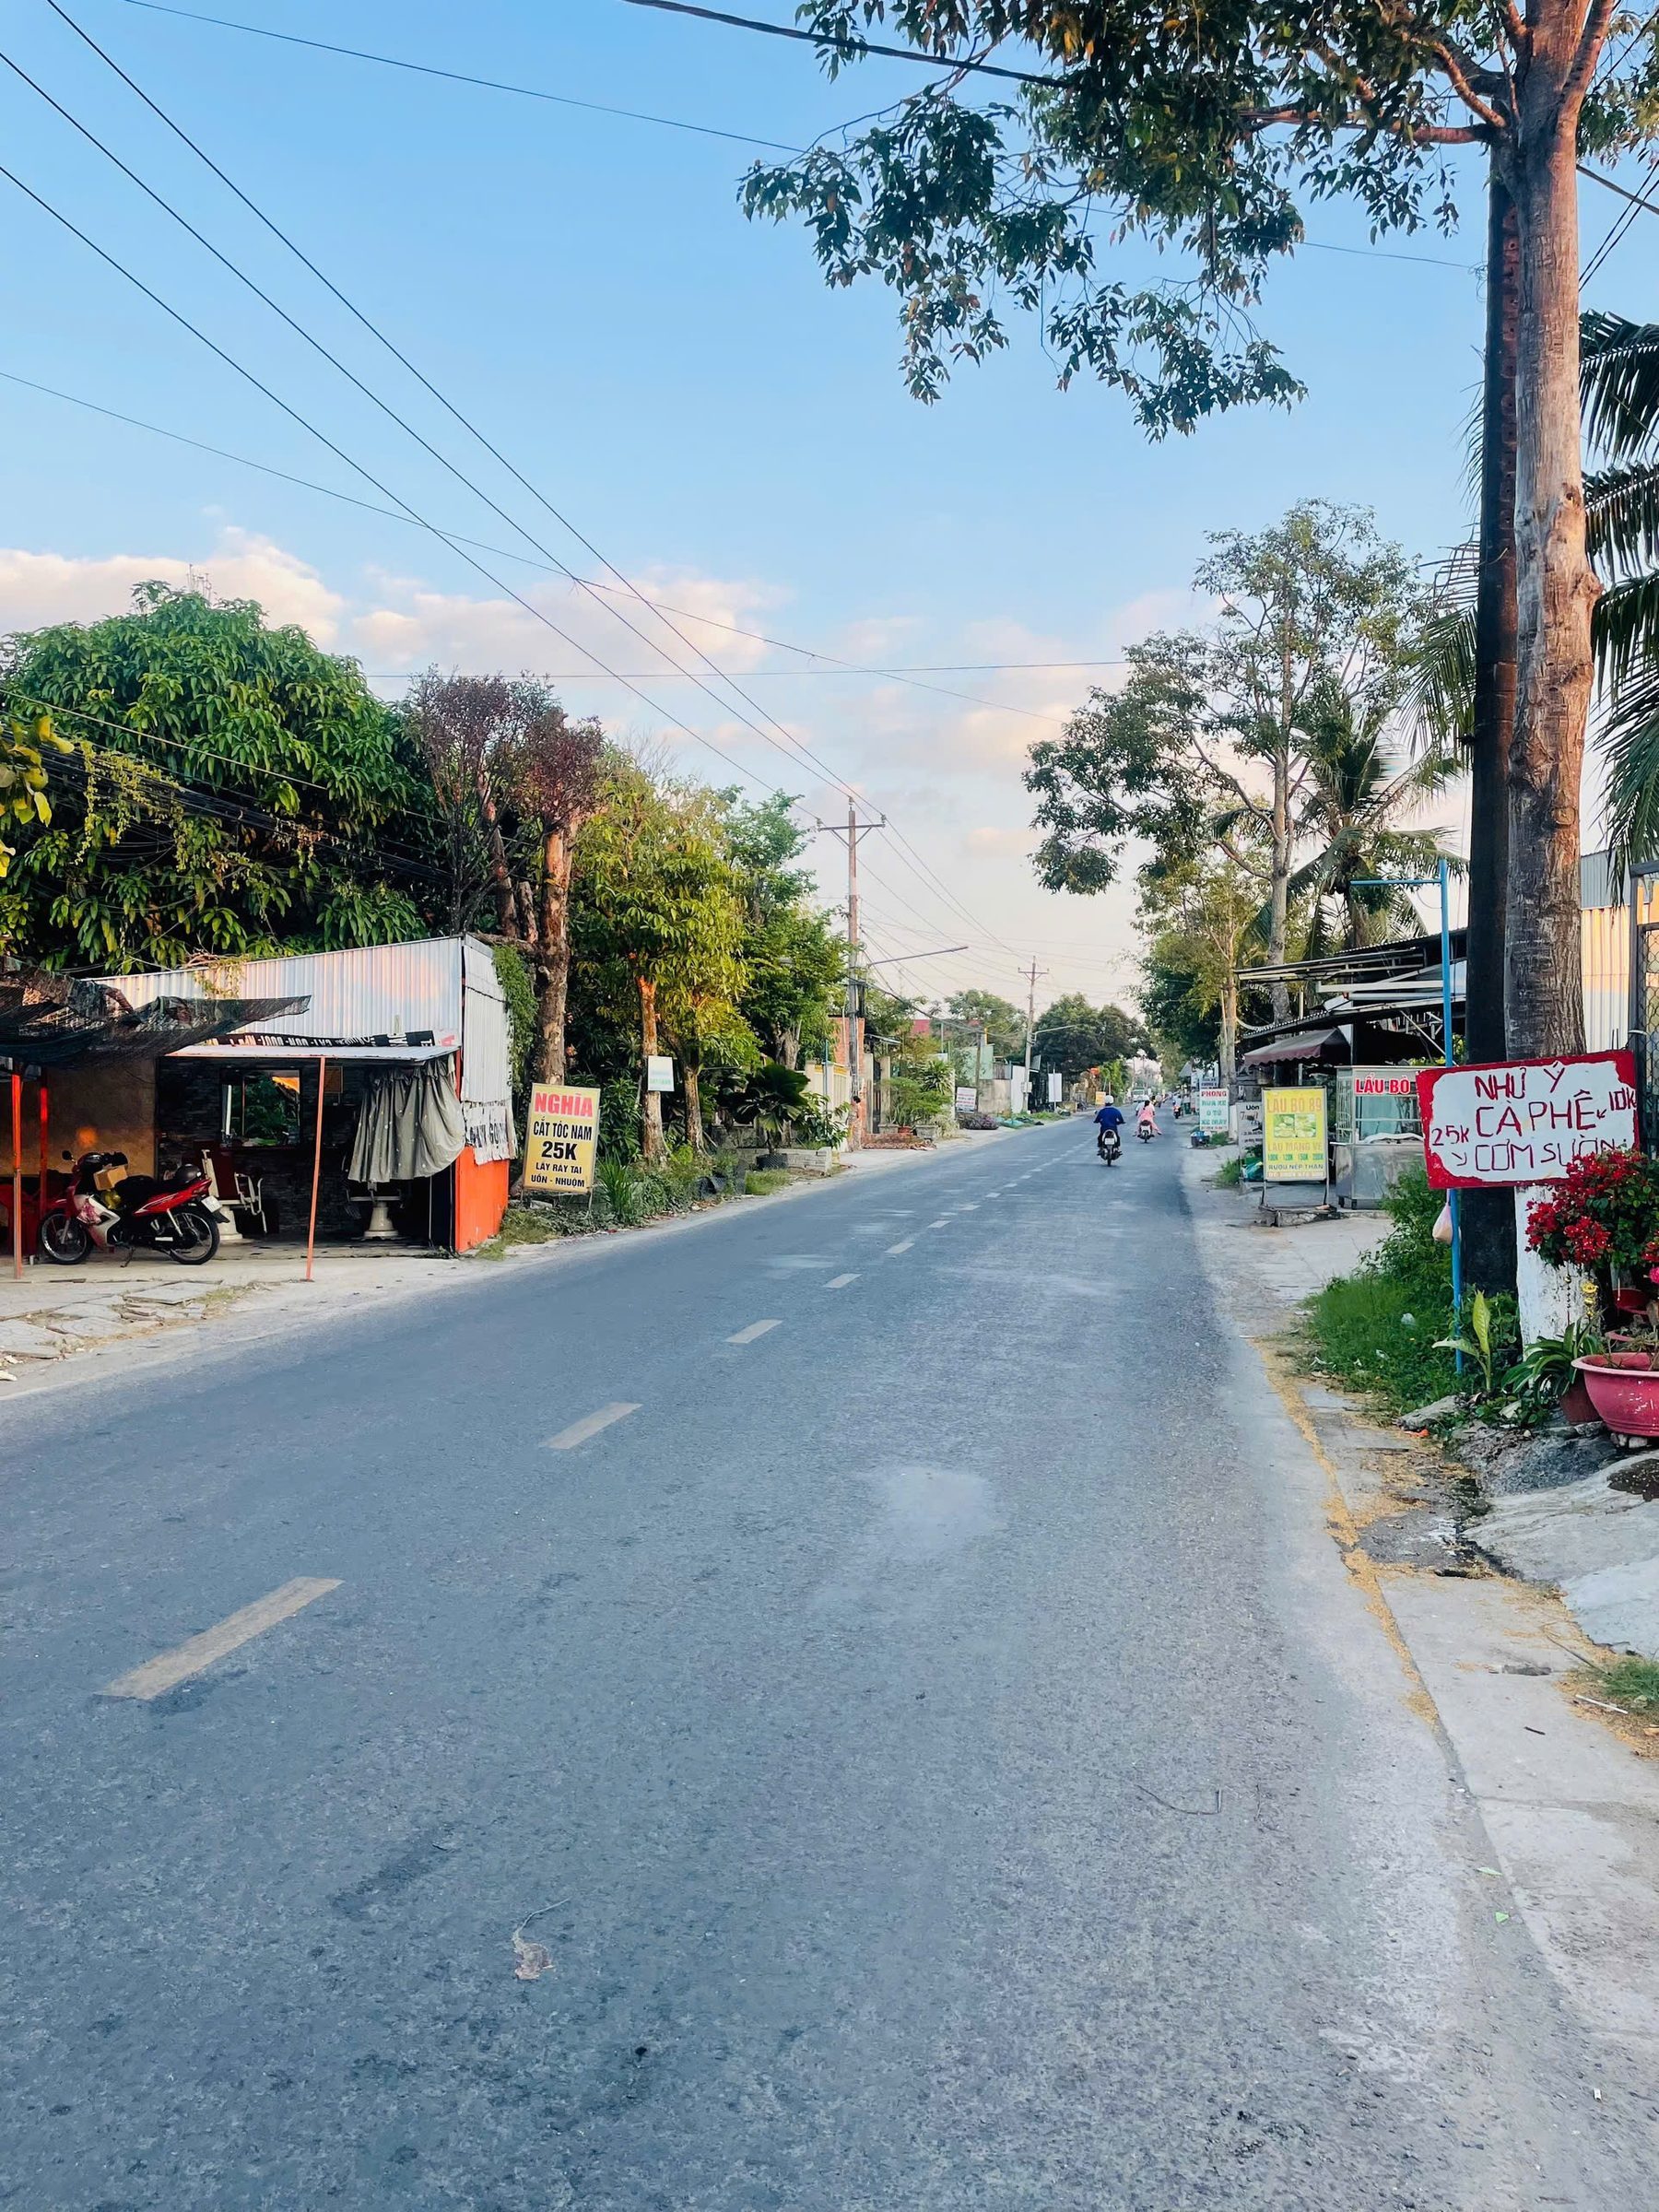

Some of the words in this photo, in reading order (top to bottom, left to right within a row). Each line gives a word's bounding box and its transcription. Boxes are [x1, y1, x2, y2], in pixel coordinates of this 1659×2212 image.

[534, 1092, 593, 1118] NGHĨA
[533, 1115, 550, 1136] CẮT
[571, 1125, 593, 1141] NAM
[541, 1140, 578, 1161] 25K
[571, 1167, 582, 1175] TAI
